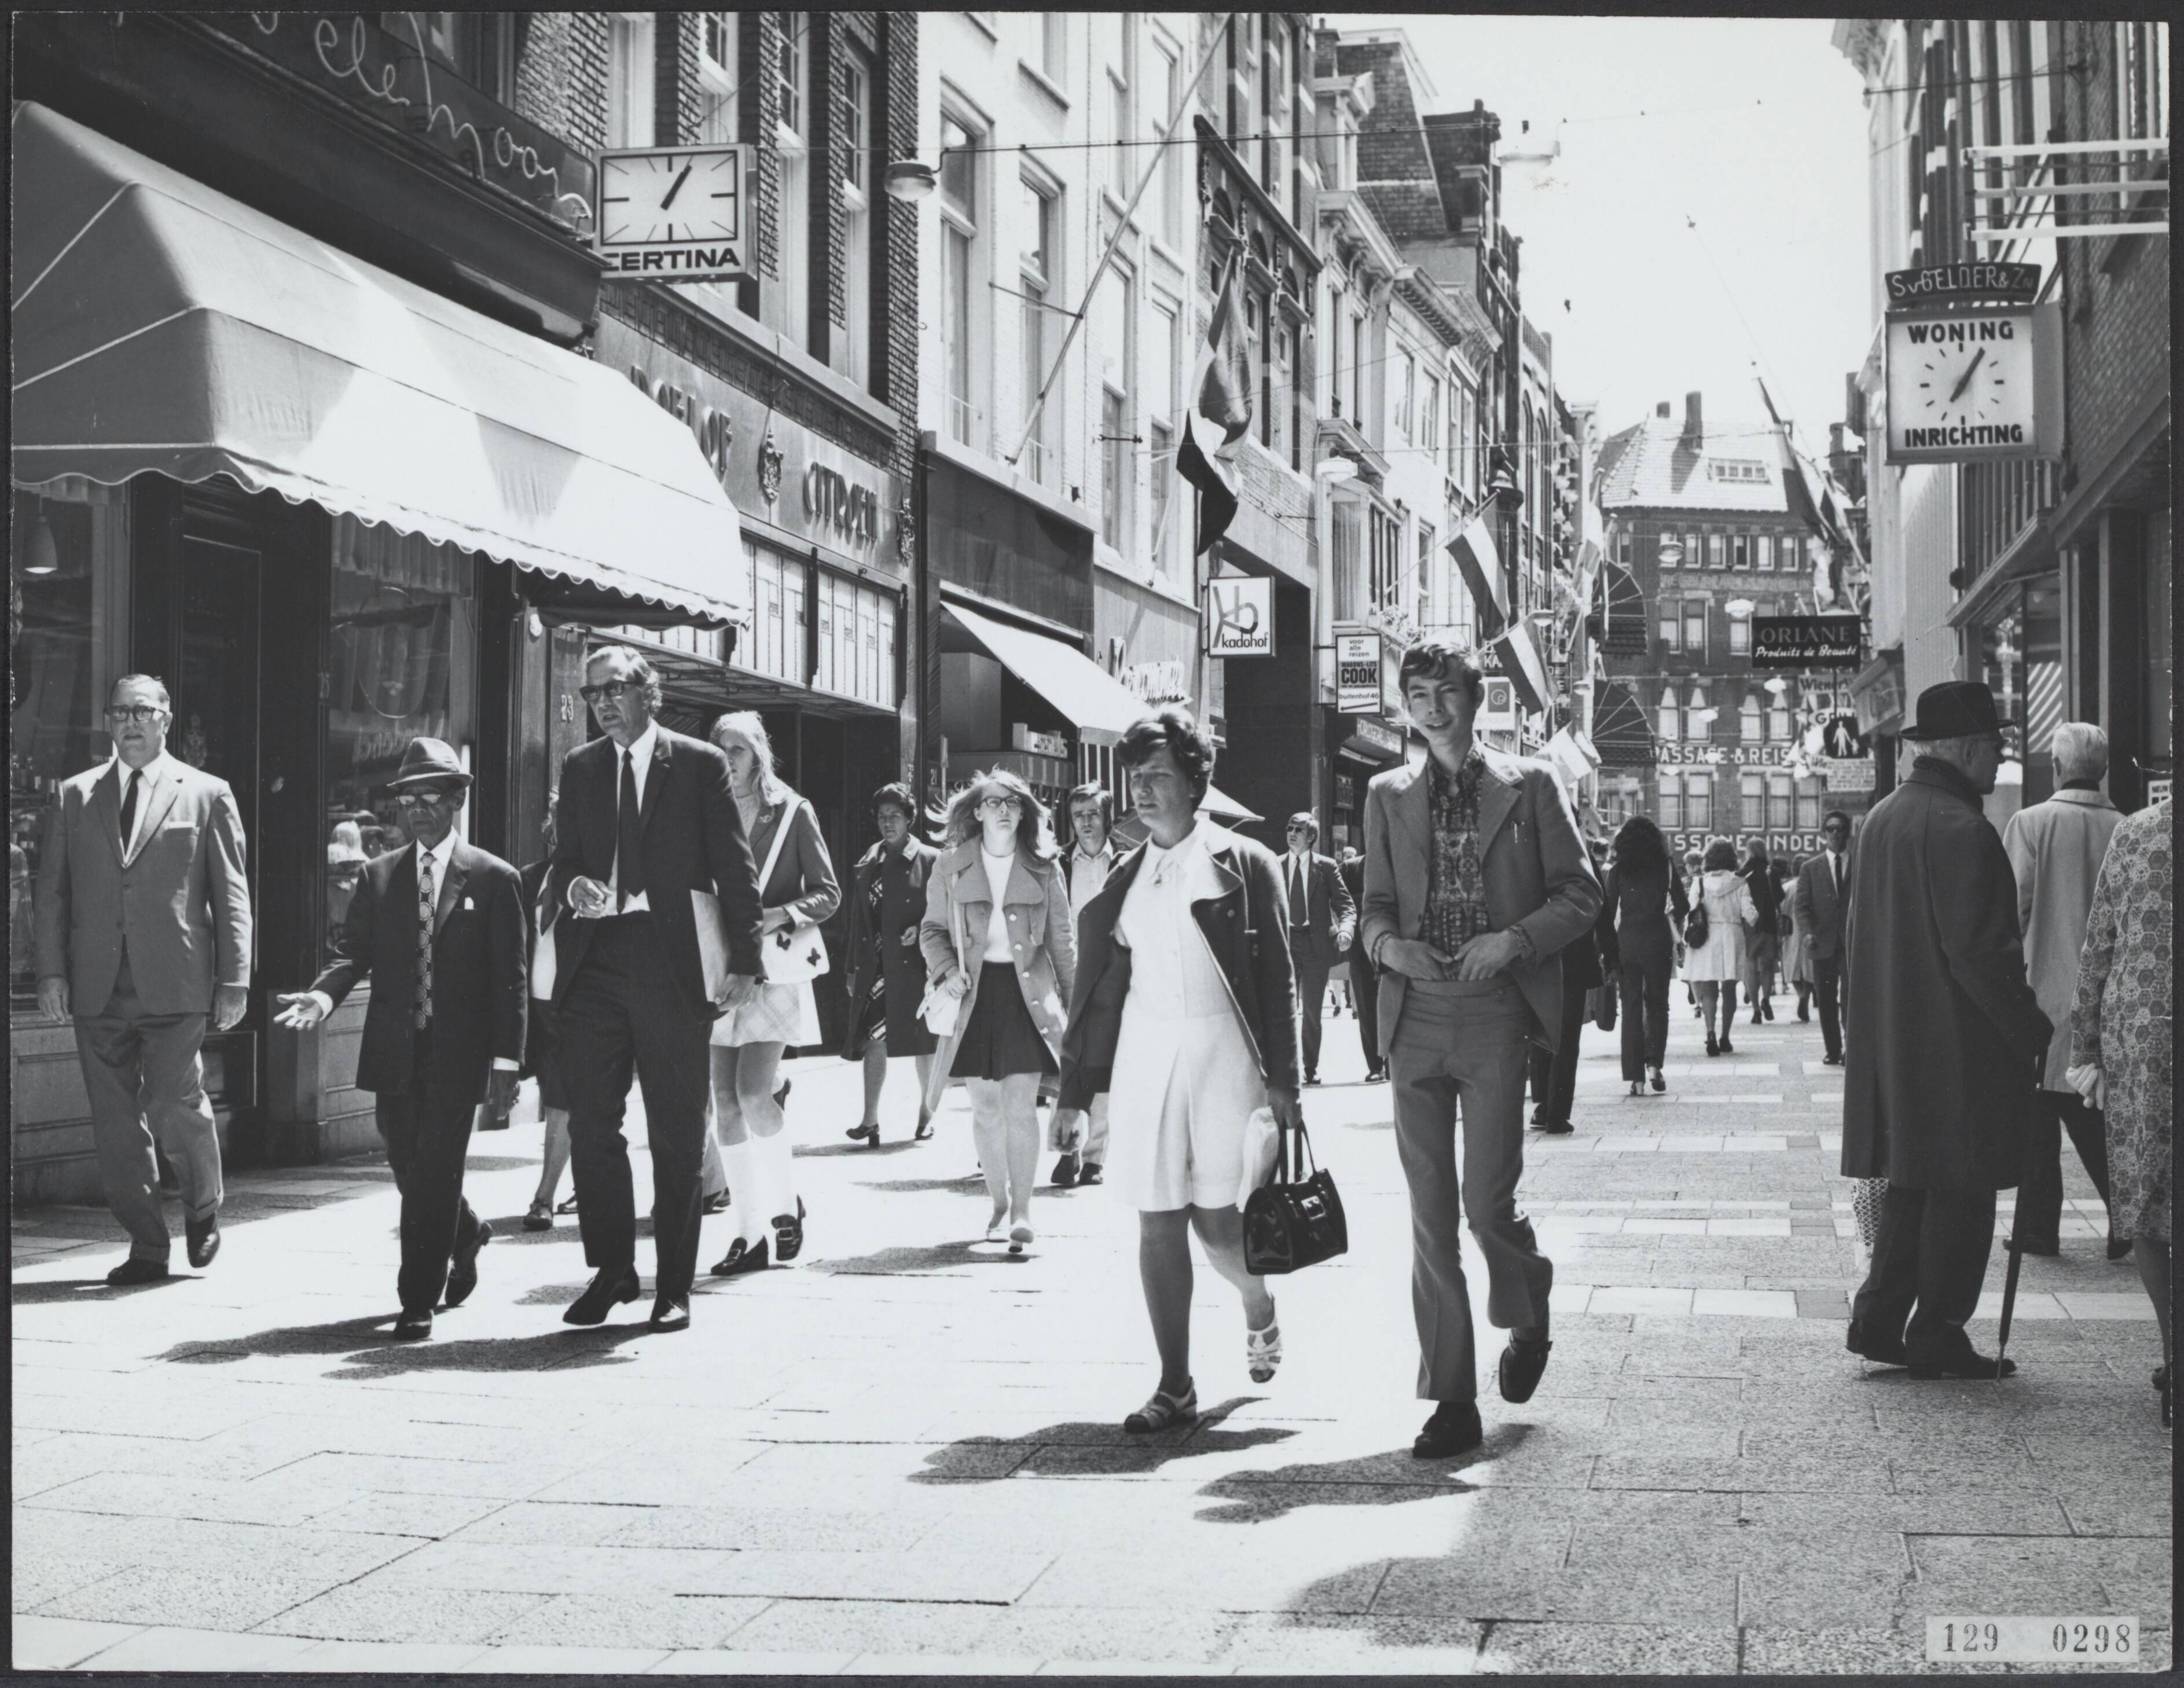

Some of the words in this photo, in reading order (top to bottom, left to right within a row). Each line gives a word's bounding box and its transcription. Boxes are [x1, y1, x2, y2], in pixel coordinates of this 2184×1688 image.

[1907, 321, 2014, 344] WONING
[1904, 424, 2023, 448] INRICHTING
[1222, 632, 1269, 648] kadohof
[1760, 626, 1851, 643] ORLANE
[1755, 645, 1801, 658] Produits
[1803, 647, 1815, 656] de
[1341, 668, 1377, 684] COOK
[561, 694, 574, 721] 23
